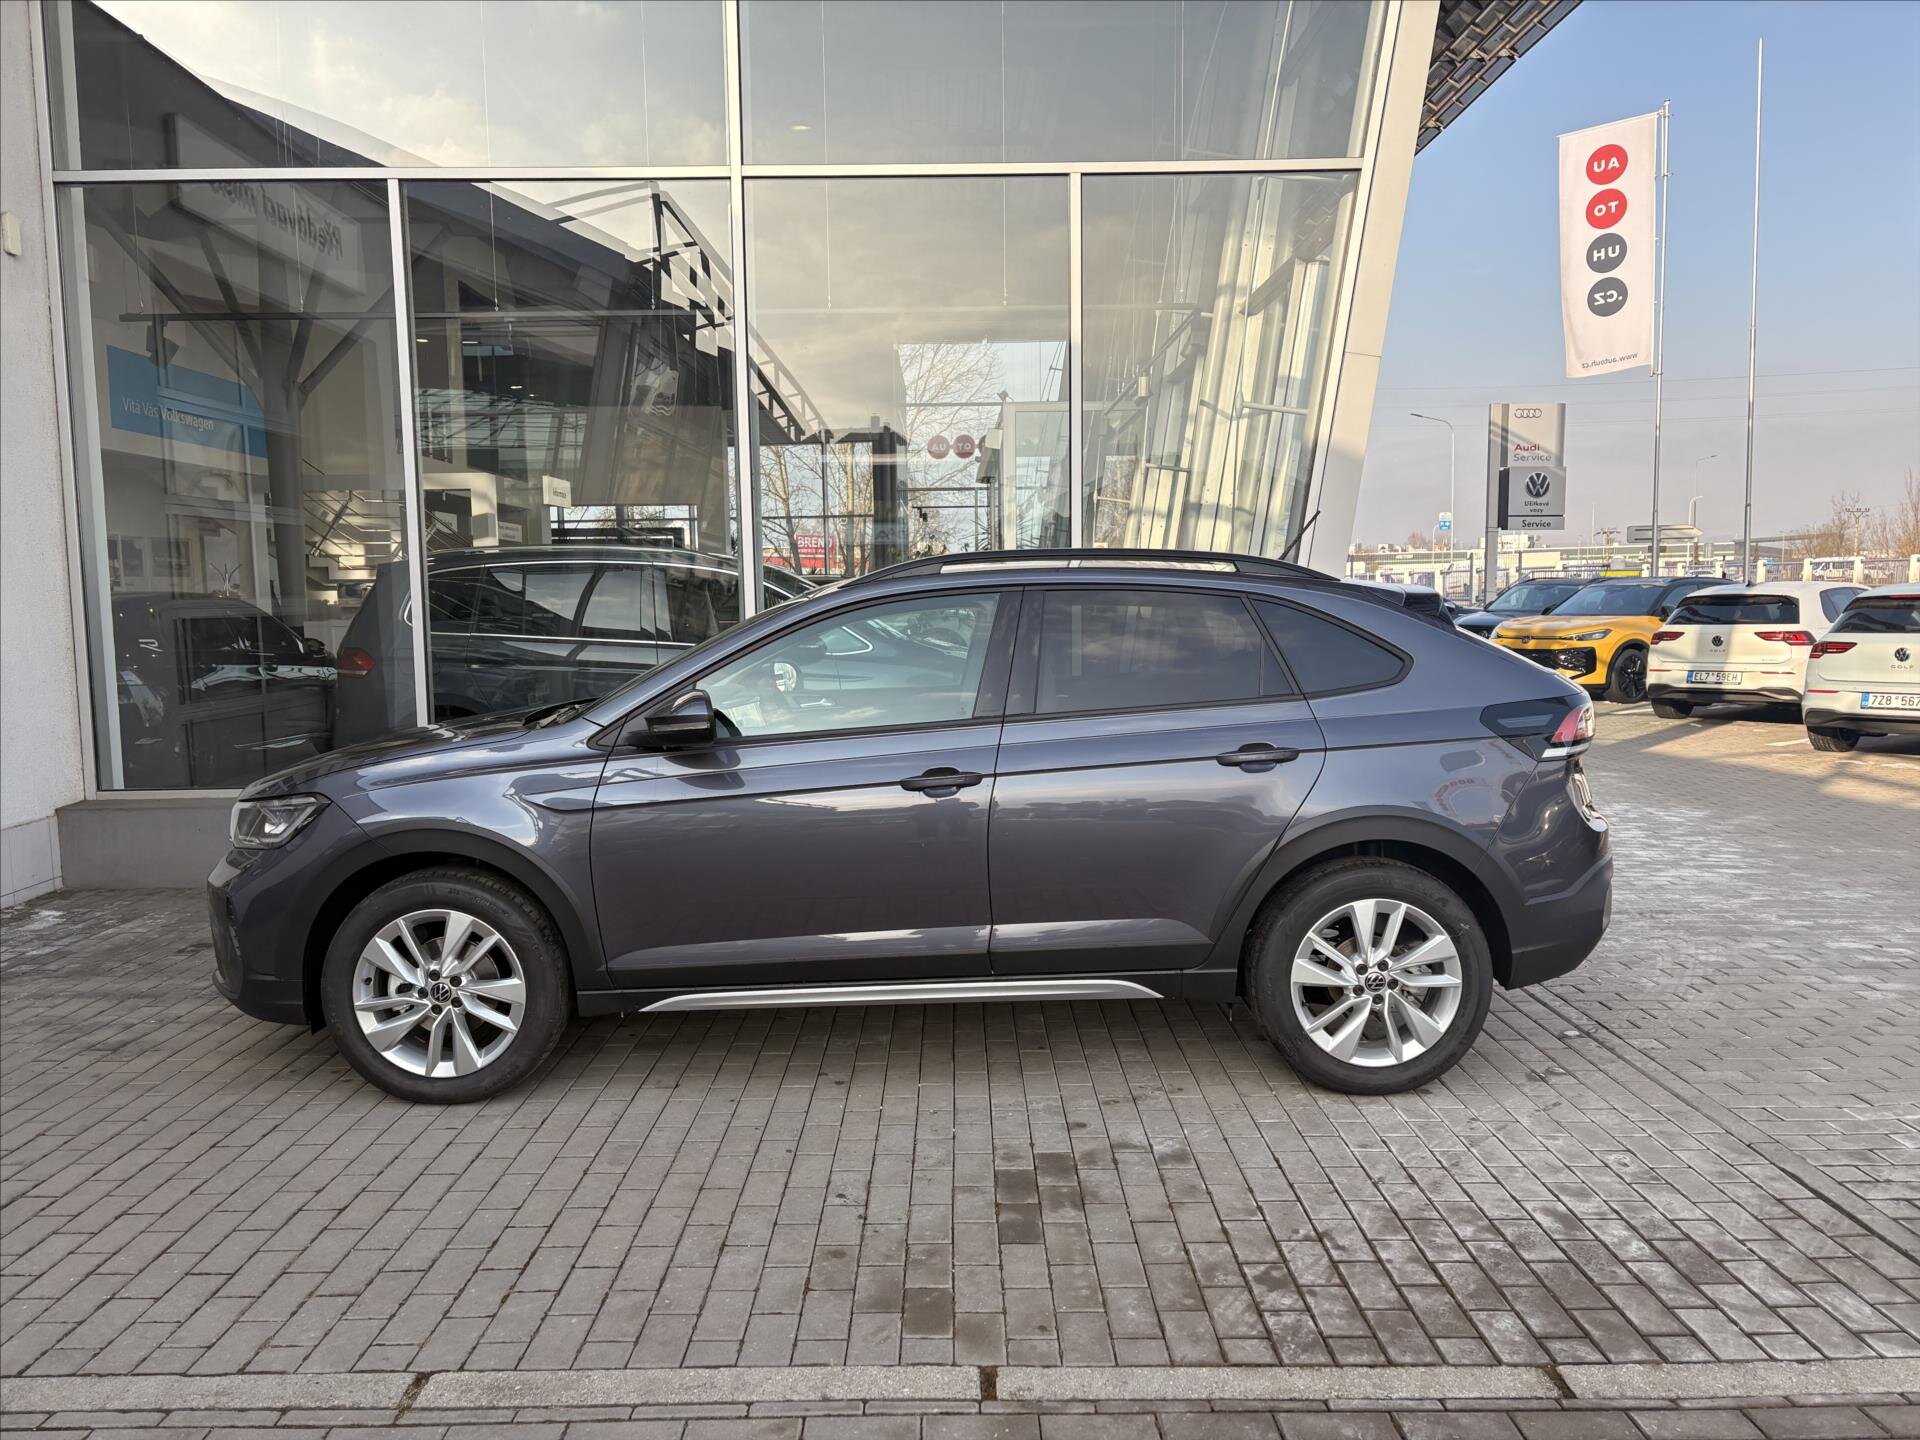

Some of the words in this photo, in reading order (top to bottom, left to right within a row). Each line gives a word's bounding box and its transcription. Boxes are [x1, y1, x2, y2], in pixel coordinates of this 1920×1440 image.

[160, 405, 215, 431] Volkswagen
[1514, 443, 1540, 452] Audi
[1513, 454, 1552, 462] Service
[1522, 519, 1552, 528] Service
[1694, 672, 1710, 681] EL7
[1871, 695, 1892, 706] 7Z8
